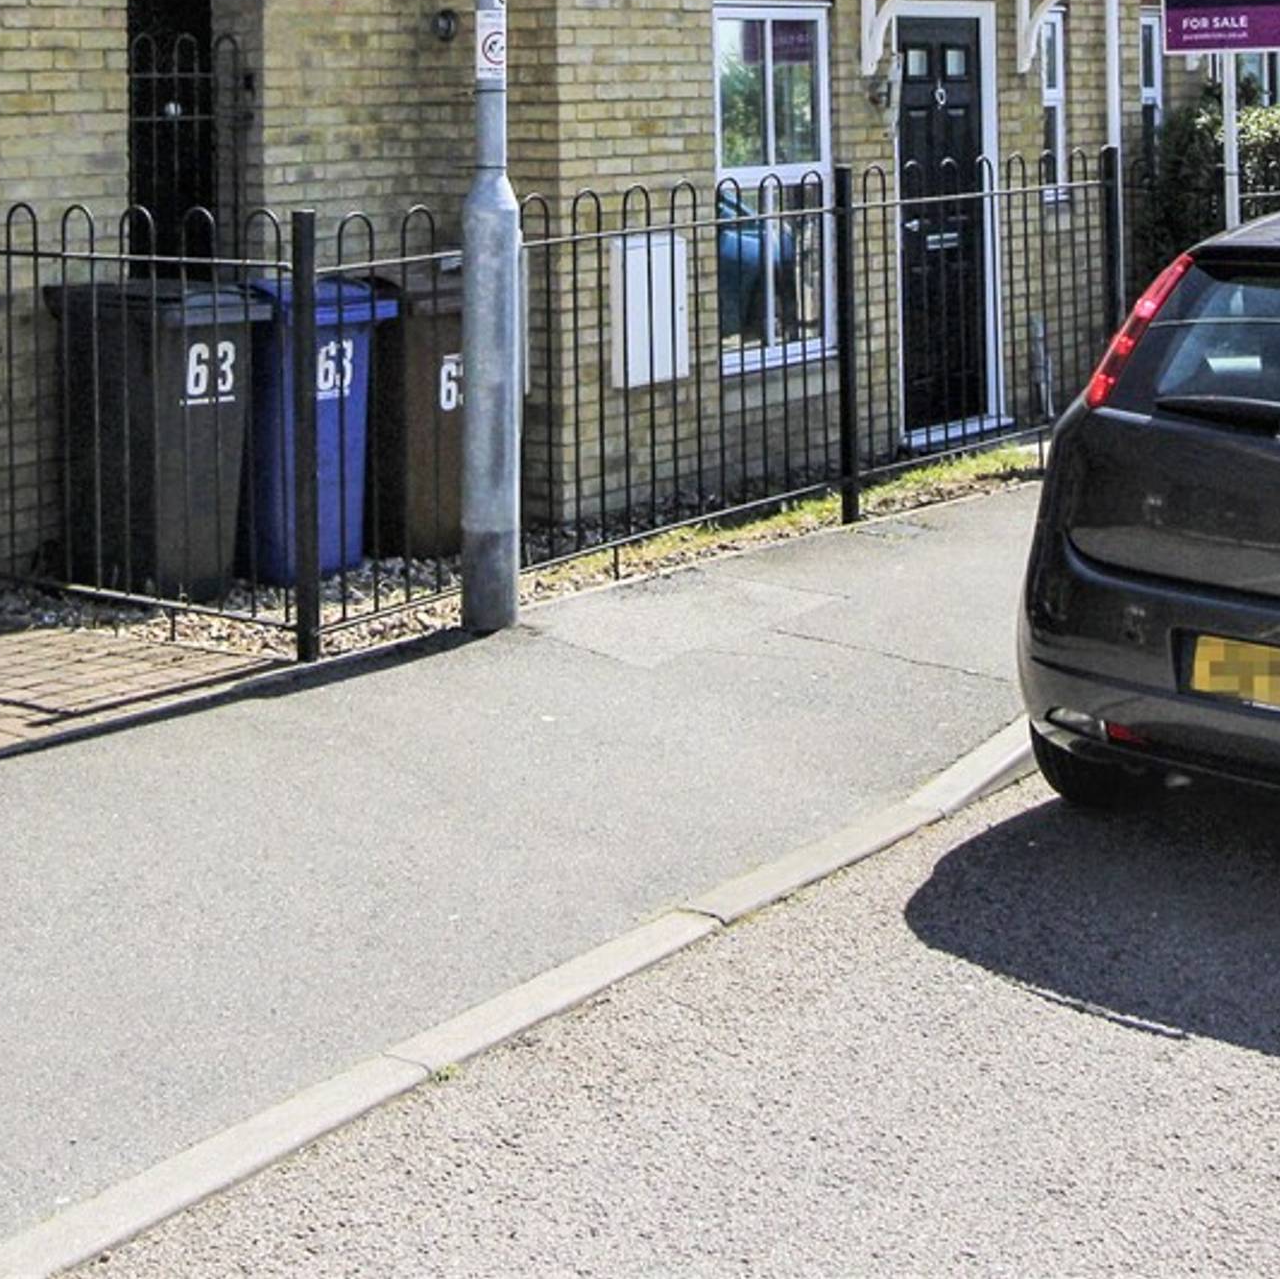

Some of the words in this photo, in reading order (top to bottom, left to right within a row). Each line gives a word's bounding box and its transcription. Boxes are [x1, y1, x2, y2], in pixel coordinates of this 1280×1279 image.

[1182, 16, 1209, 30] FOR
[1212, 15, 1248, 28] SALE
[187, 341, 236, 396] 63
[317, 339, 353, 391] 63
[441, 361, 464, 411] 6
